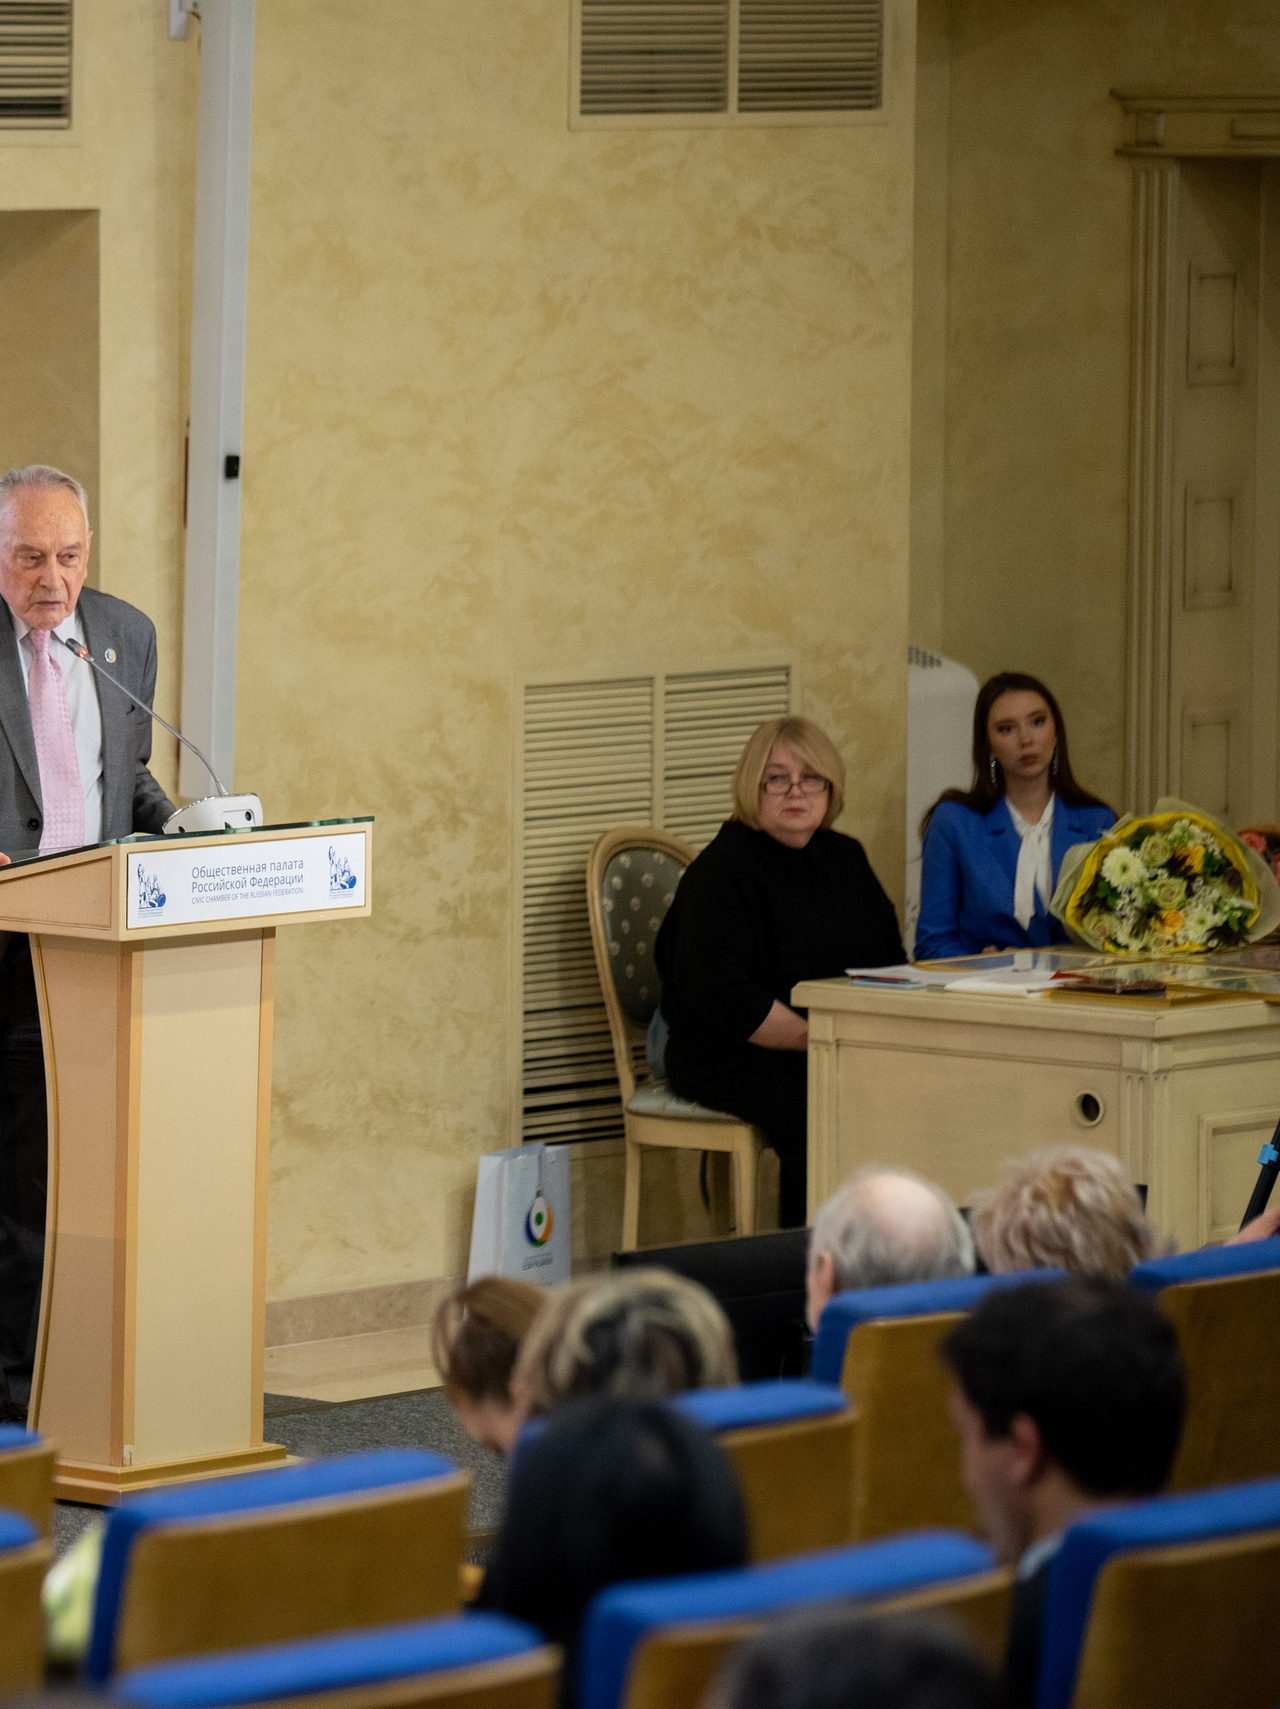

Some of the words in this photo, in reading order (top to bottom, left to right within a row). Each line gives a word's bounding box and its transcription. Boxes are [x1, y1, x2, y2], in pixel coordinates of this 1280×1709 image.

[191, 863, 267, 879] Общественная
[269, 859, 304, 873] палата
[191, 876, 247, 893] Российской
[249, 873, 304, 889] Федерации
[191, 896, 204, 904] CIVIC
[206, 894, 230, 903] CHAMBER
[231, 893, 238, 901] OF
[240, 892, 249, 900] THE
[250, 890, 271, 899] RUSSIAN
[272, 887, 304, 897] FEDERATION
